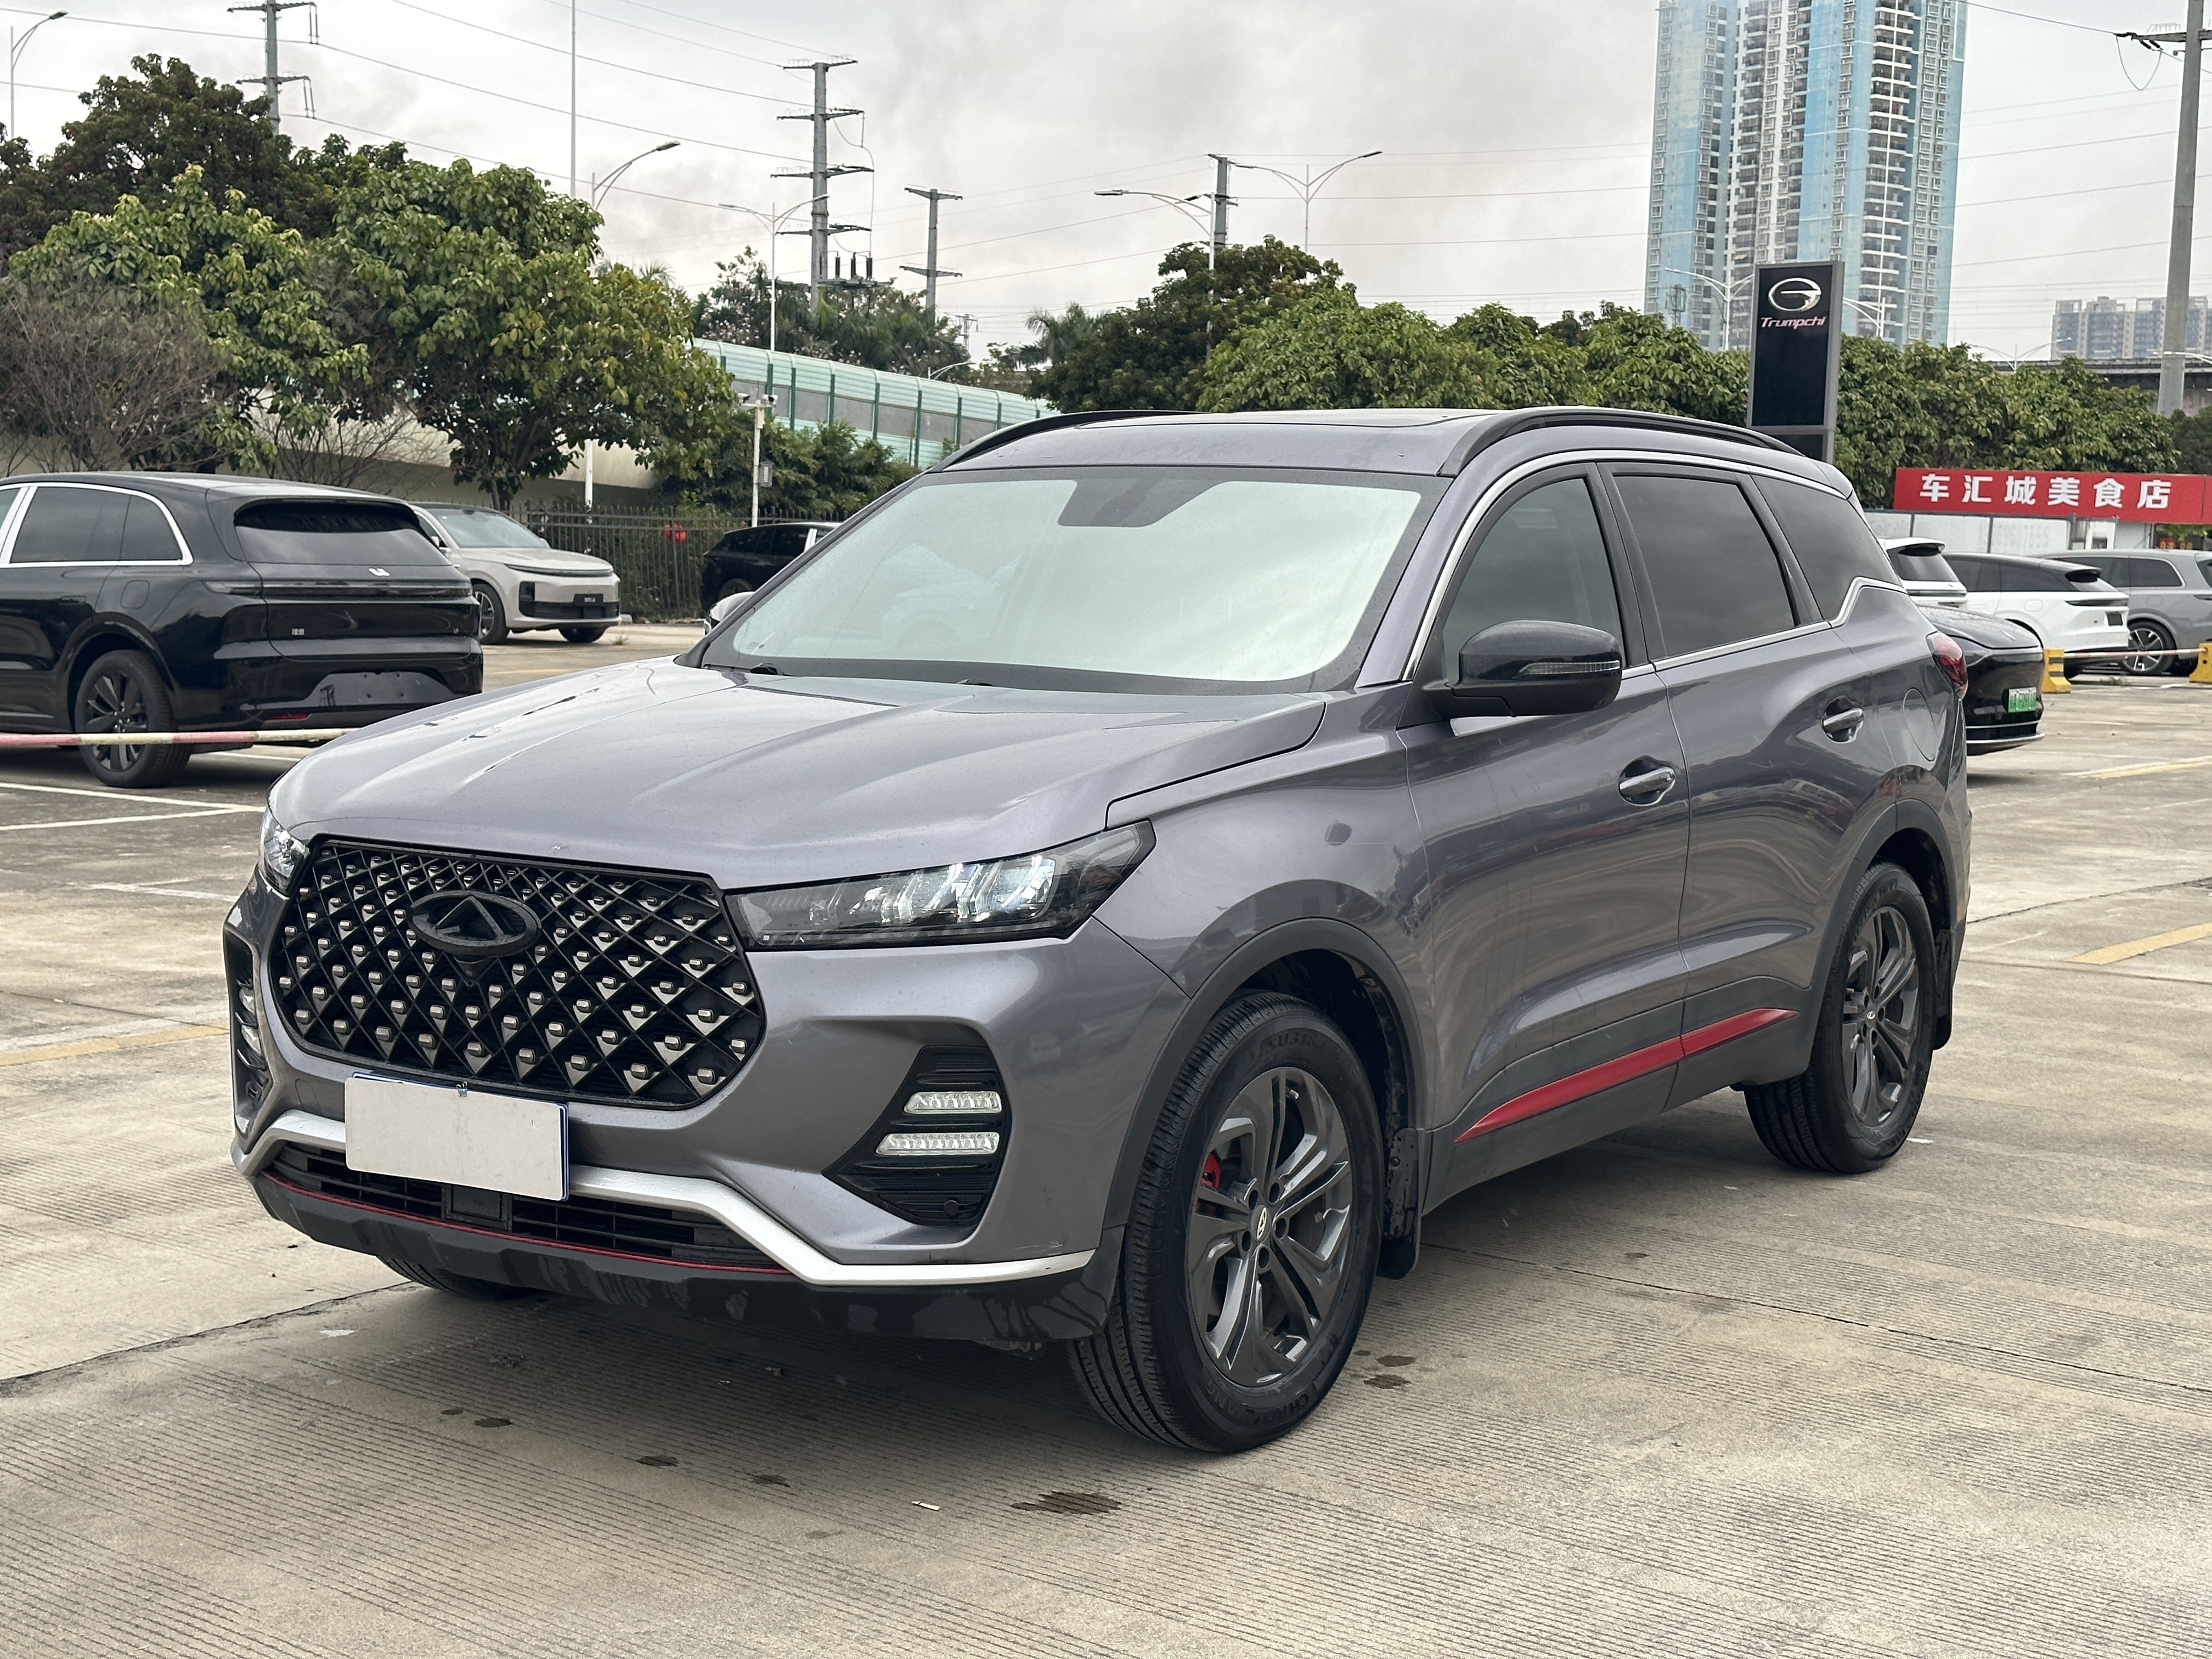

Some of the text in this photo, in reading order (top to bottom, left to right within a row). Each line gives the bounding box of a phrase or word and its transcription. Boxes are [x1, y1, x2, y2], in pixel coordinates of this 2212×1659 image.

[1760, 316, 1826, 329] Trumpchi
[1920, 473, 2171, 509] 车汇城美食店
